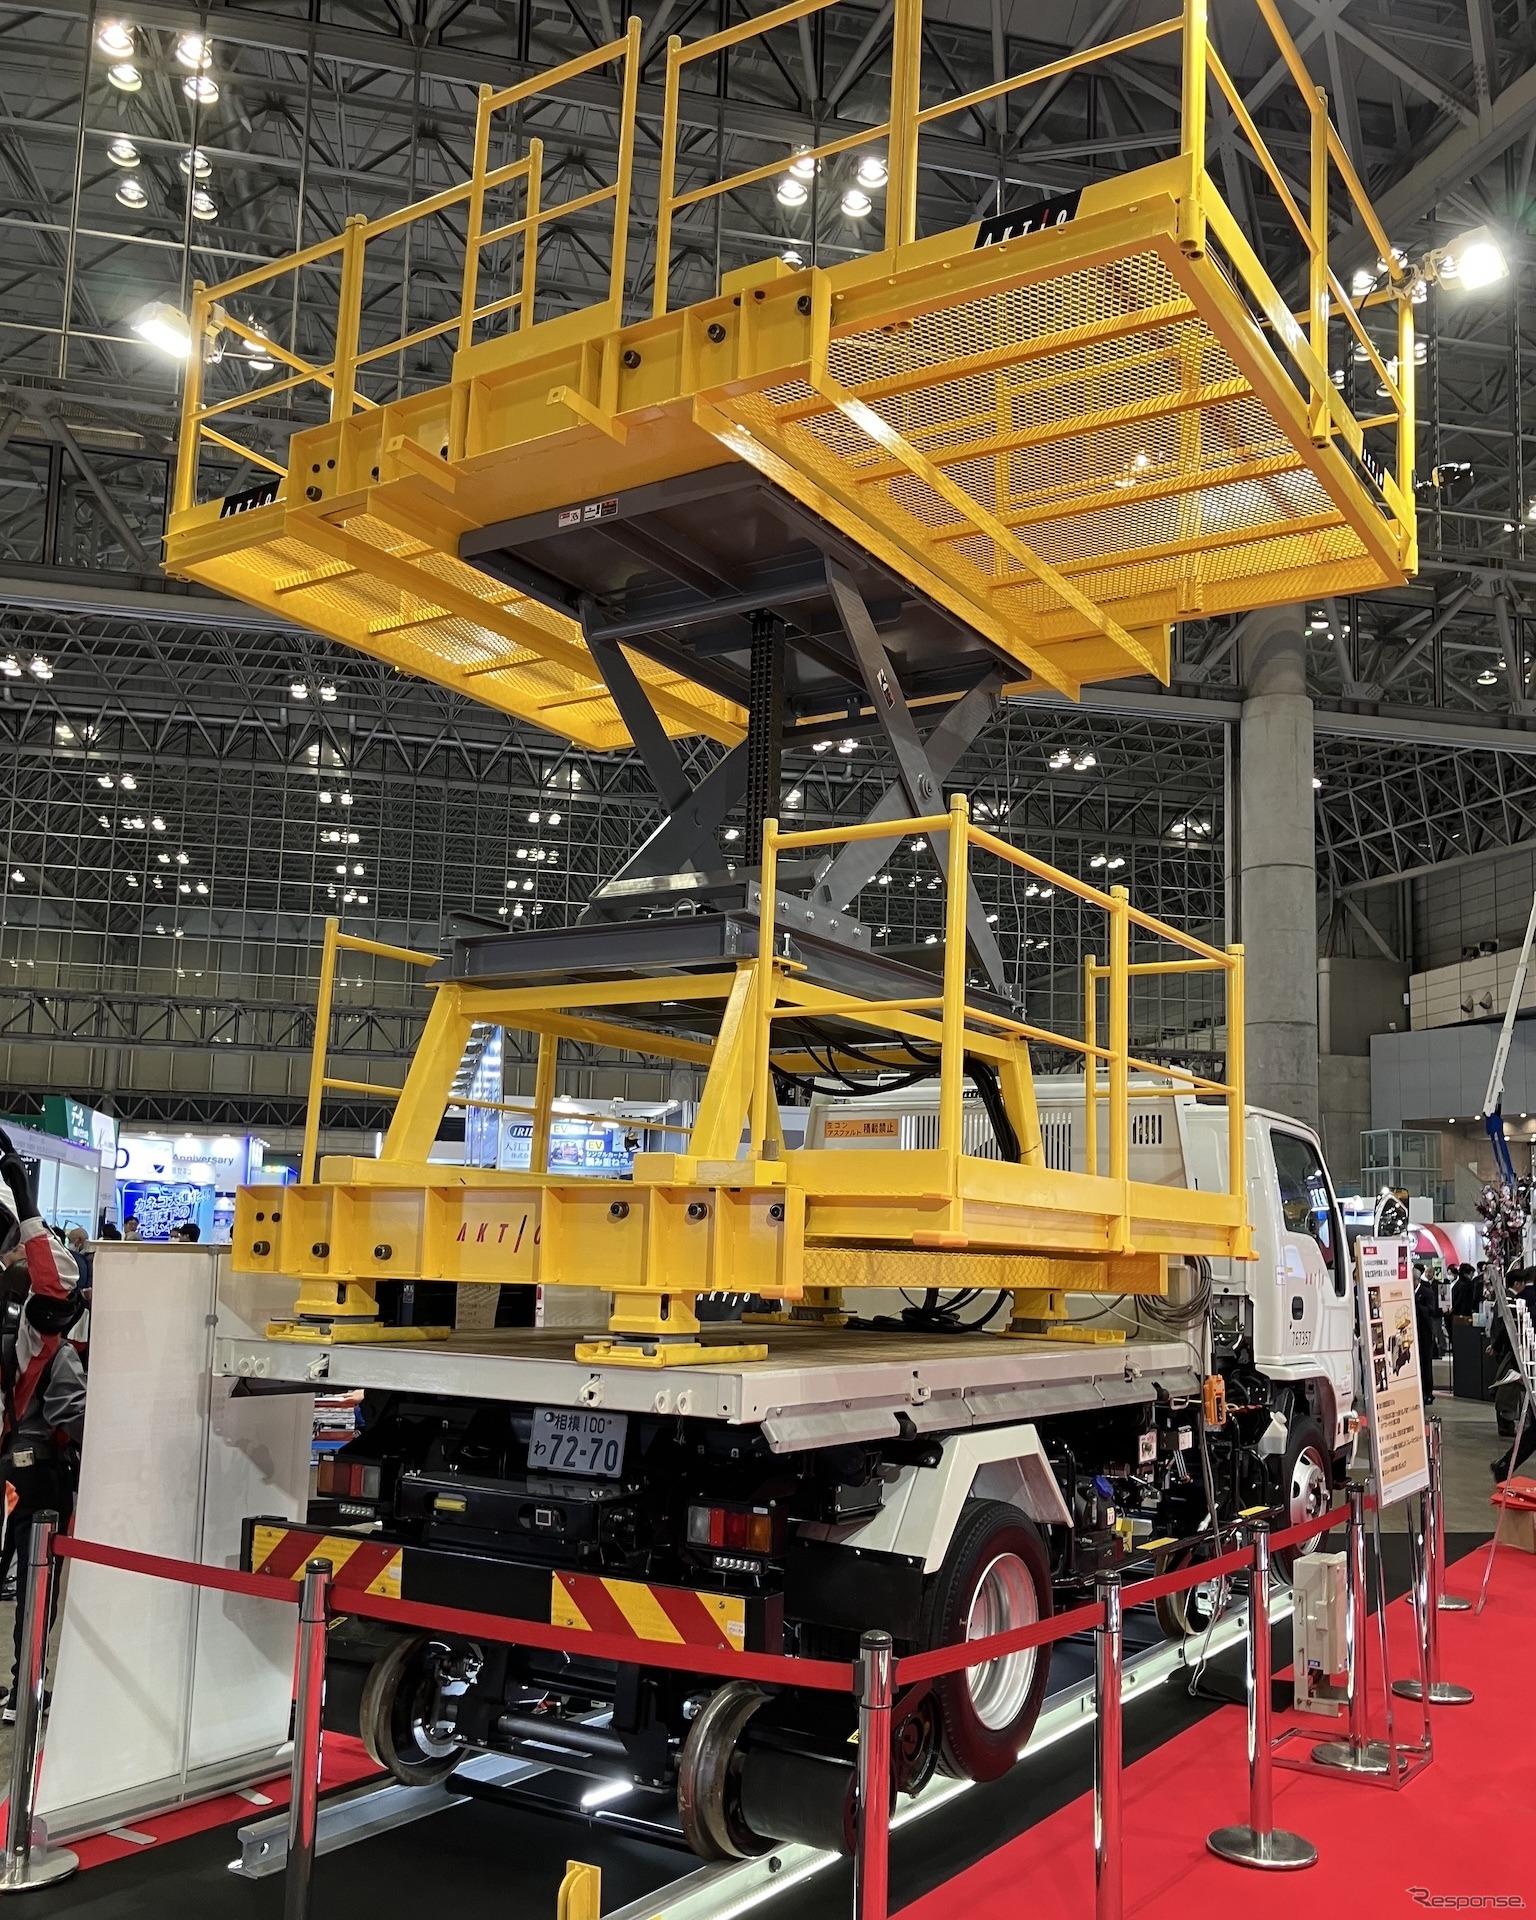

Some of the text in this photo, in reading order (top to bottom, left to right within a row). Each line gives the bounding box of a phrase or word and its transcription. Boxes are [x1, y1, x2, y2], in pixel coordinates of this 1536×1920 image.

[827, 1129, 862, 1137] アスファルト
[863, 1122, 894, 1134] 積載禁止
[588, 1141, 603, 1150] EV
[172, 1153, 234, 1166] Anniversary
[554, 1414, 606, 1434] 相模 100
[533, 1434, 619, 1472] わ 72-70
